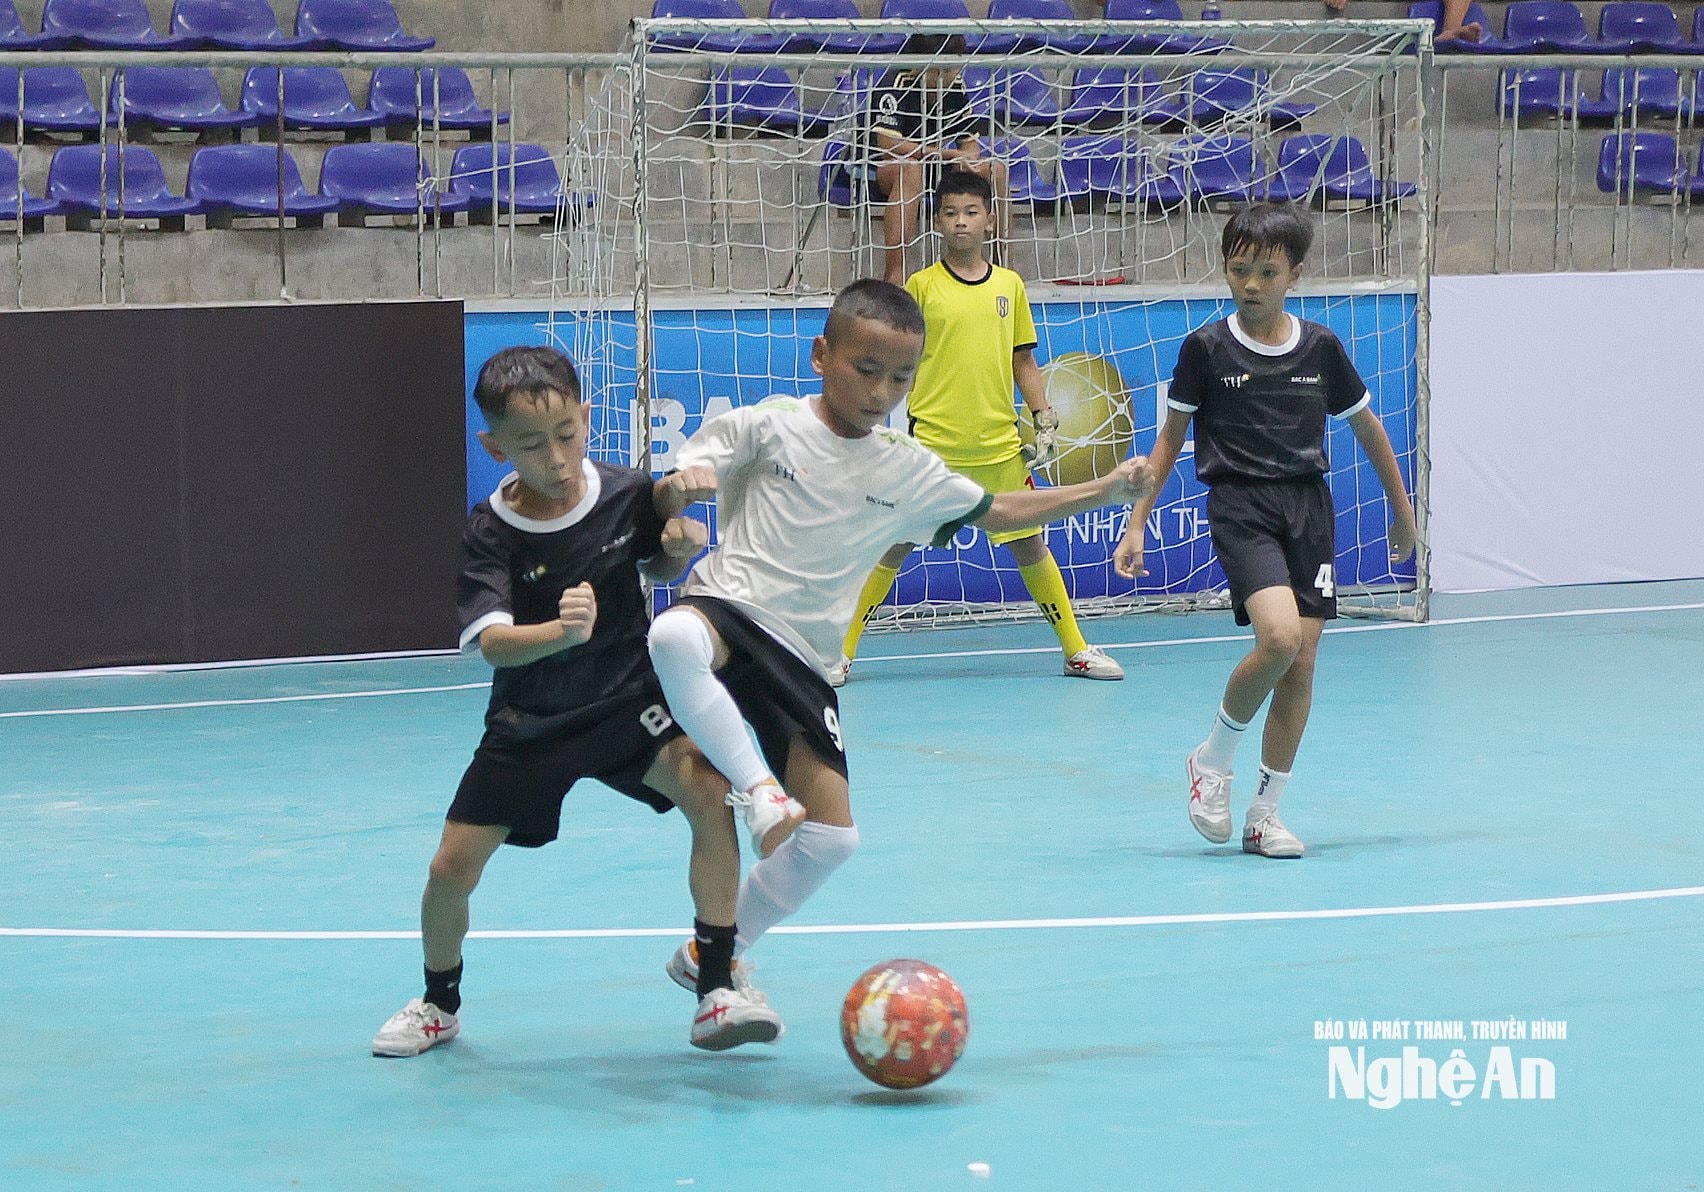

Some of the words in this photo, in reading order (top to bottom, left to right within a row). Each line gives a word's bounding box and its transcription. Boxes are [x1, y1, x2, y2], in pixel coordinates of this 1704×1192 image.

[1171, 507, 1210, 539] TH
[1314, 563, 1334, 598] 4
[640, 704, 672, 737] 8
[823, 706, 844, 752] 9
